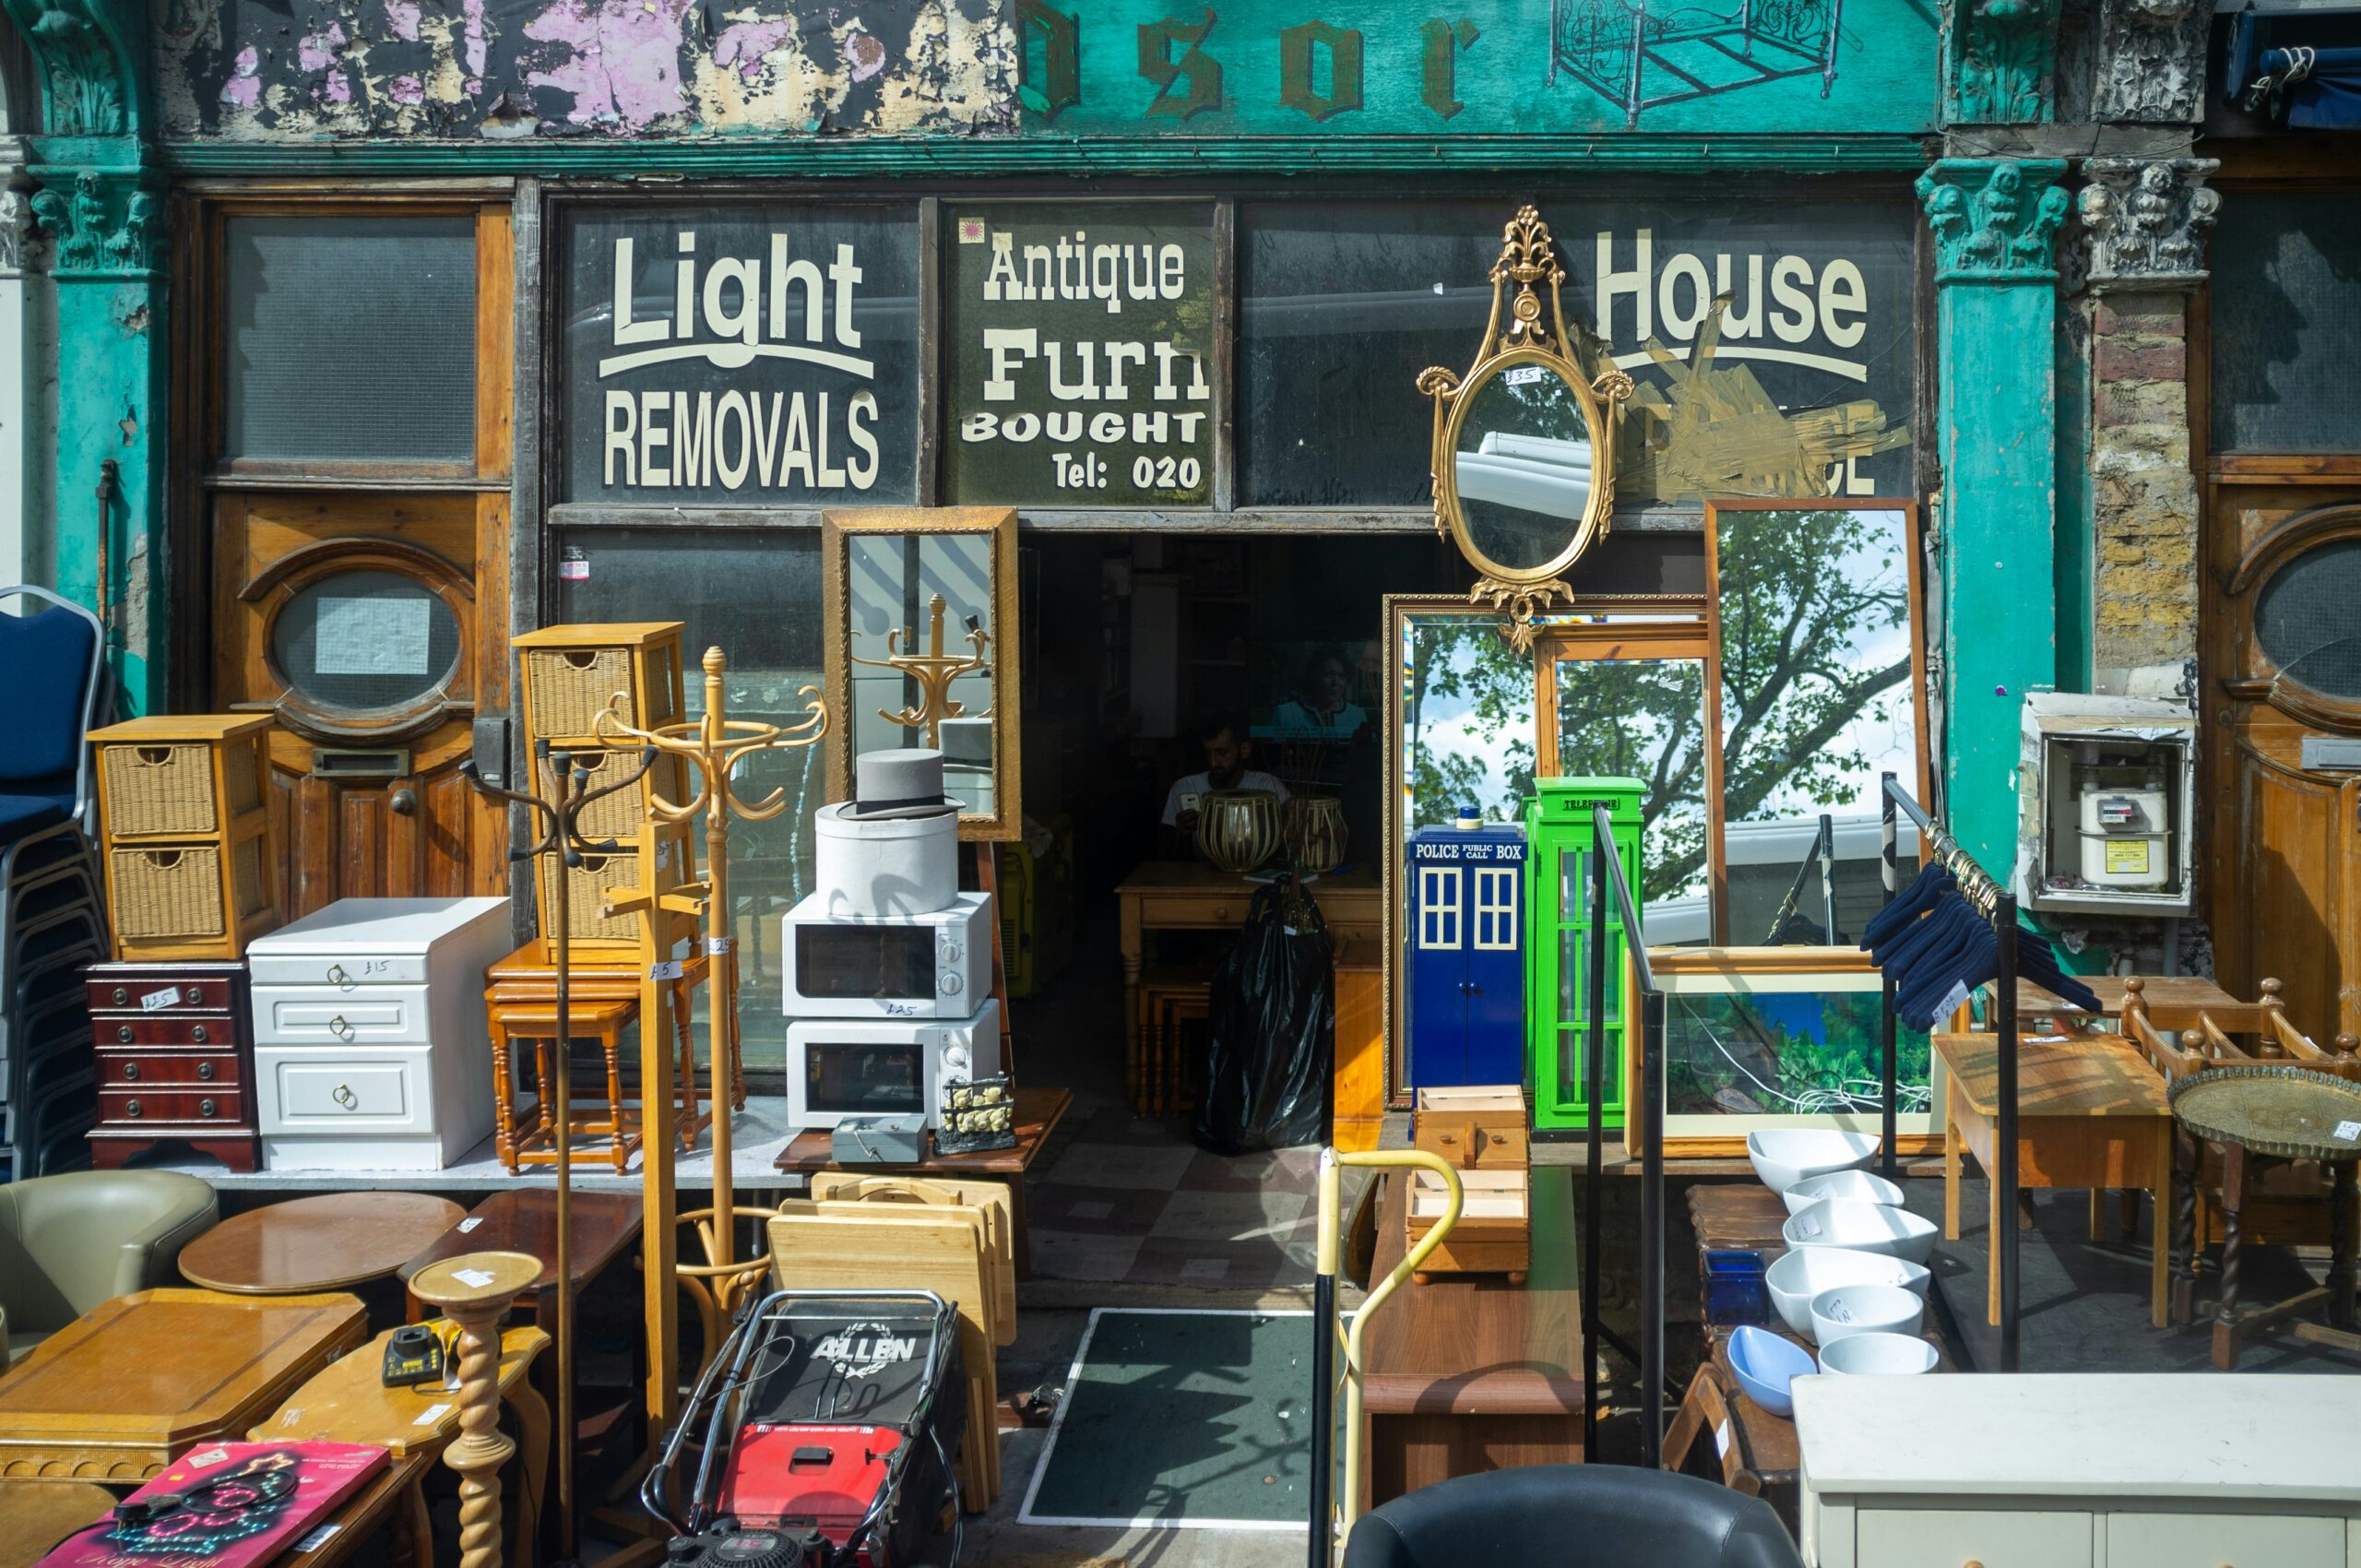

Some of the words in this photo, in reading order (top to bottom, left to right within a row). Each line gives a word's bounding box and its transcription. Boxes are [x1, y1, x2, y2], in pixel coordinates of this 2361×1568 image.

[983, 231, 1184, 314] Antique
[614, 232, 862, 362] Light
[1596, 228, 1868, 348] House
[983, 327, 1210, 400] Furn
[604, 389, 879, 490] REMOVALS
[961, 411, 1206, 443] BOUGHT
[1052, 451, 1107, 488] Tel:
[1133, 456, 1200, 489] 020
[1564, 799, 1618, 809] TELEPE
[1416, 844, 1459, 859] POLICE
[1462, 844, 1493, 852] PUBLIC
[1465, 851, 1489, 860] CALL
[1496, 845, 1522, 860] BOX
[364, 959, 391, 975] £15
[886, 1004, 917, 1016] £25
[810, 1336, 917, 1362] ALLEN
